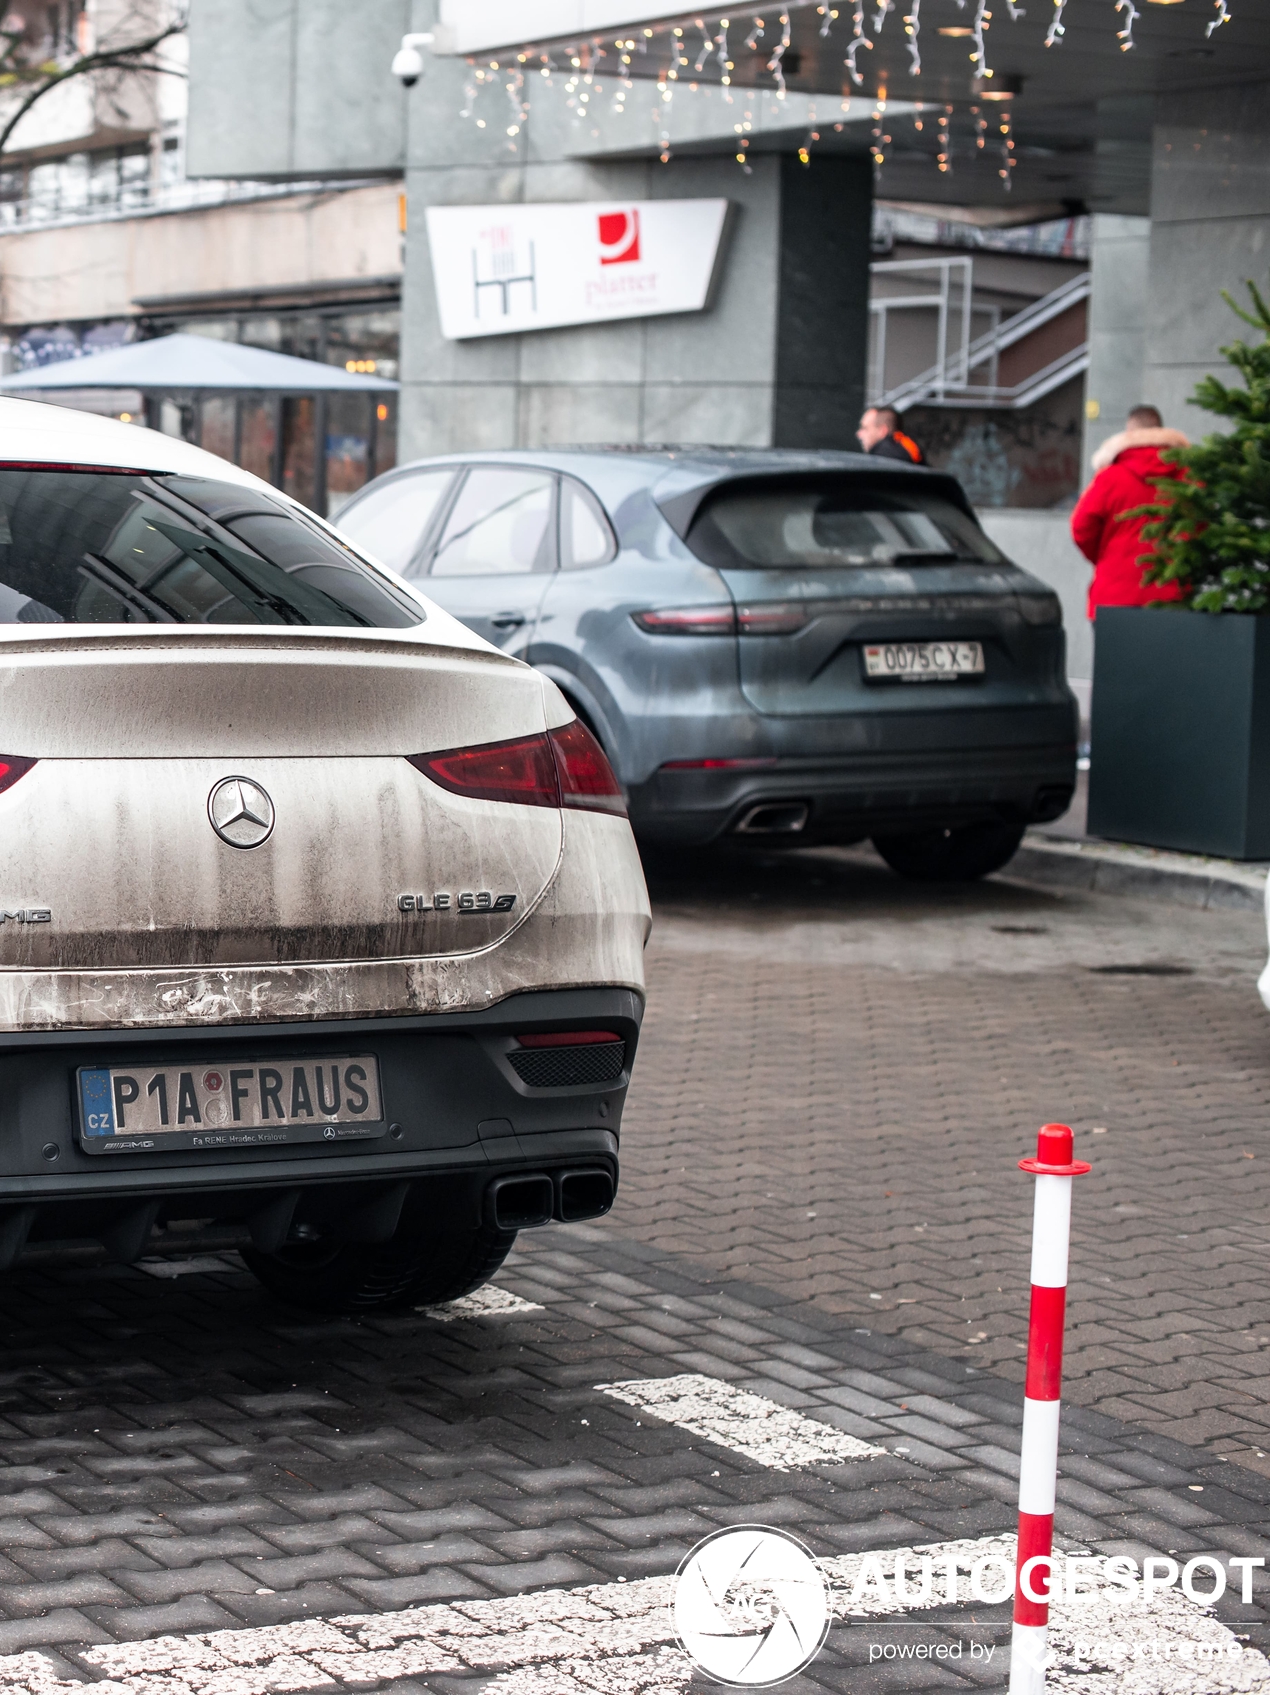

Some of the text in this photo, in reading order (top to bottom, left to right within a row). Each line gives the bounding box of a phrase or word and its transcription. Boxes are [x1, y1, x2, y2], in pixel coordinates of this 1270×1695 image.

[398, 893, 451, 911] GLE
[113, 1064, 369, 1128] P1A FRAUS
[88, 1113, 110, 1129] CZ
[205, 1135, 228, 1145] RENE
[229, 1134, 257, 1143] Hradec
